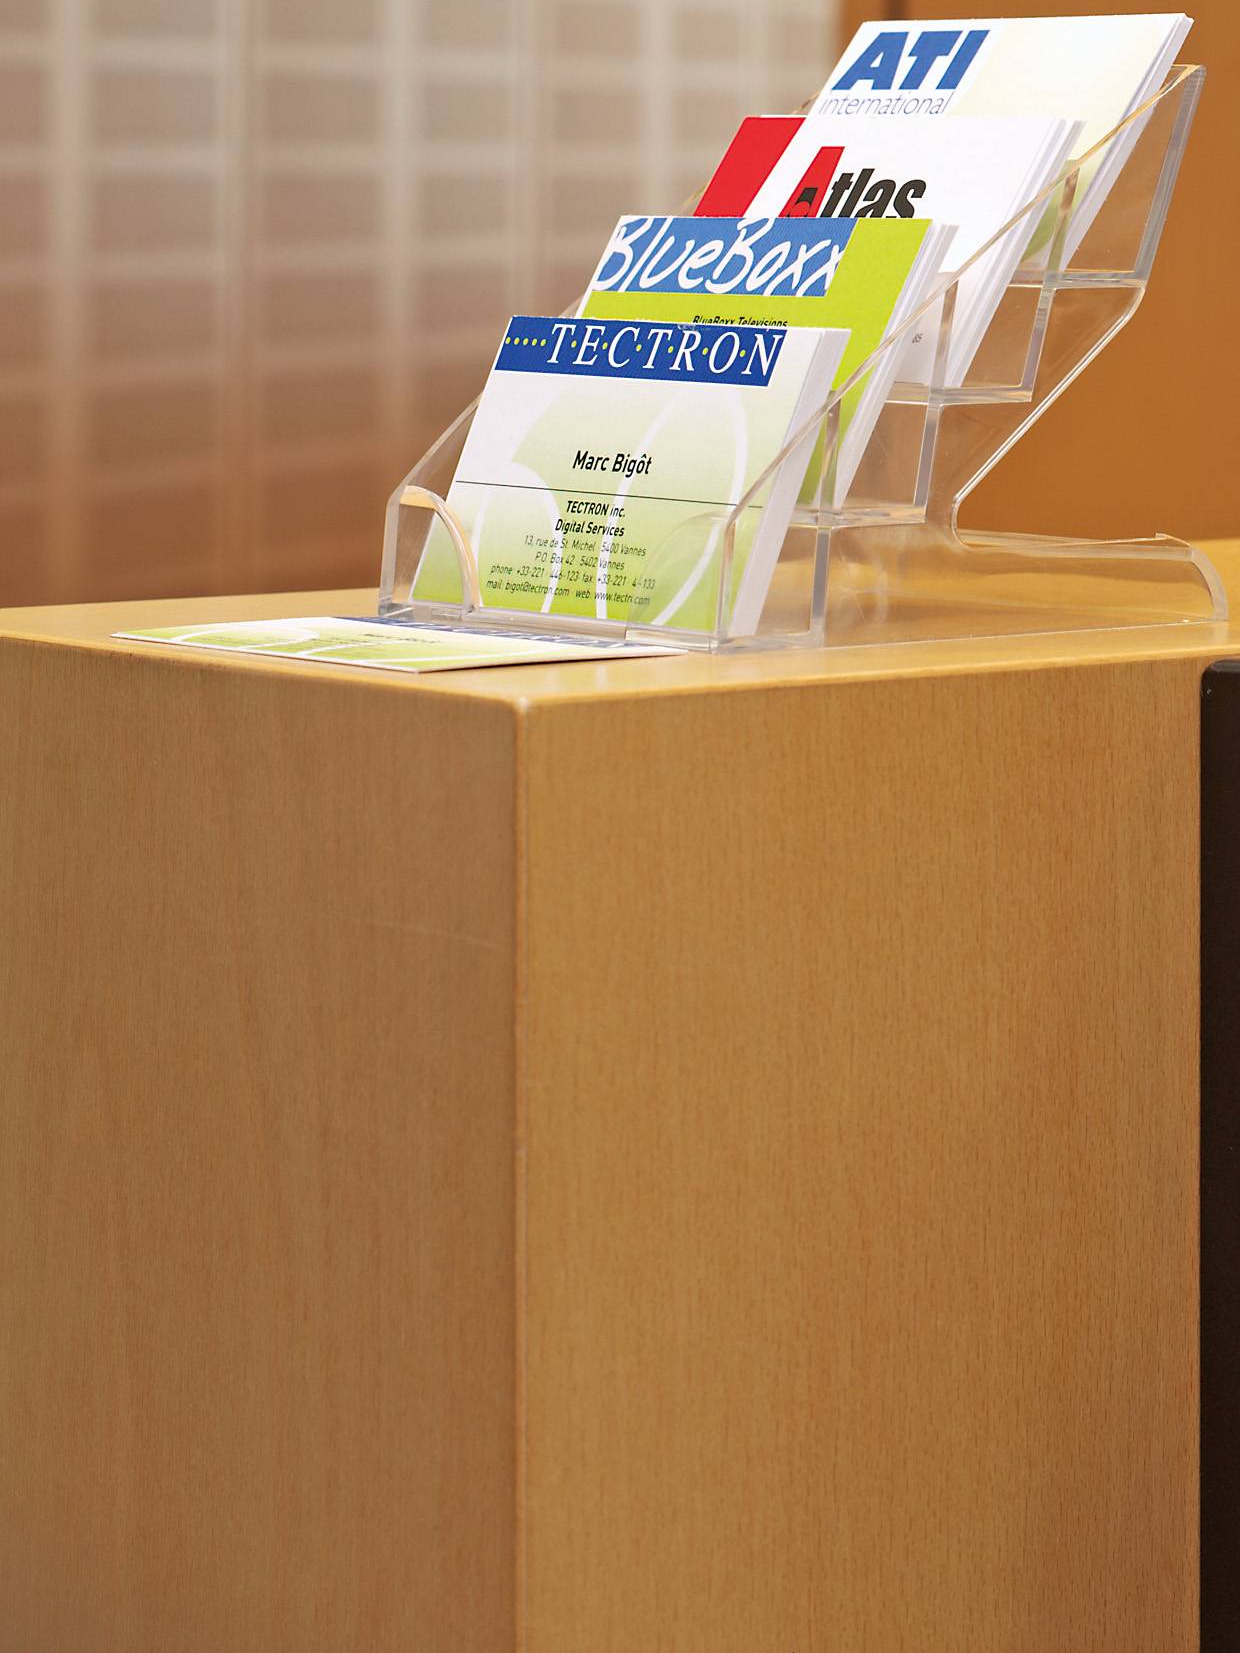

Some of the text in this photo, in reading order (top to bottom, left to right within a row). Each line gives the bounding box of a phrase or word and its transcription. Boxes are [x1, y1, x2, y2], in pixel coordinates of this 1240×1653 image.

[831, 29, 990, 91] ATI
[819, 92, 956, 116] international
[778, 146, 927, 218] Atlas
[592, 217, 841, 297] BlueBoxx
[572, 449, 653, 478] Marc Bigôt
[566, 500, 610, 516] TECTRON
[555, 518, 626, 537] Digital Services
[535, 537, 549, 547] rue
[549, 537, 559, 548] de
[571, 539, 597, 552] Michel
[620, 544, 647, 557] Vannes
[550, 552, 563, 564] Box
[565, 554, 576, 565] 42
[599, 557, 625, 570] Vannes
